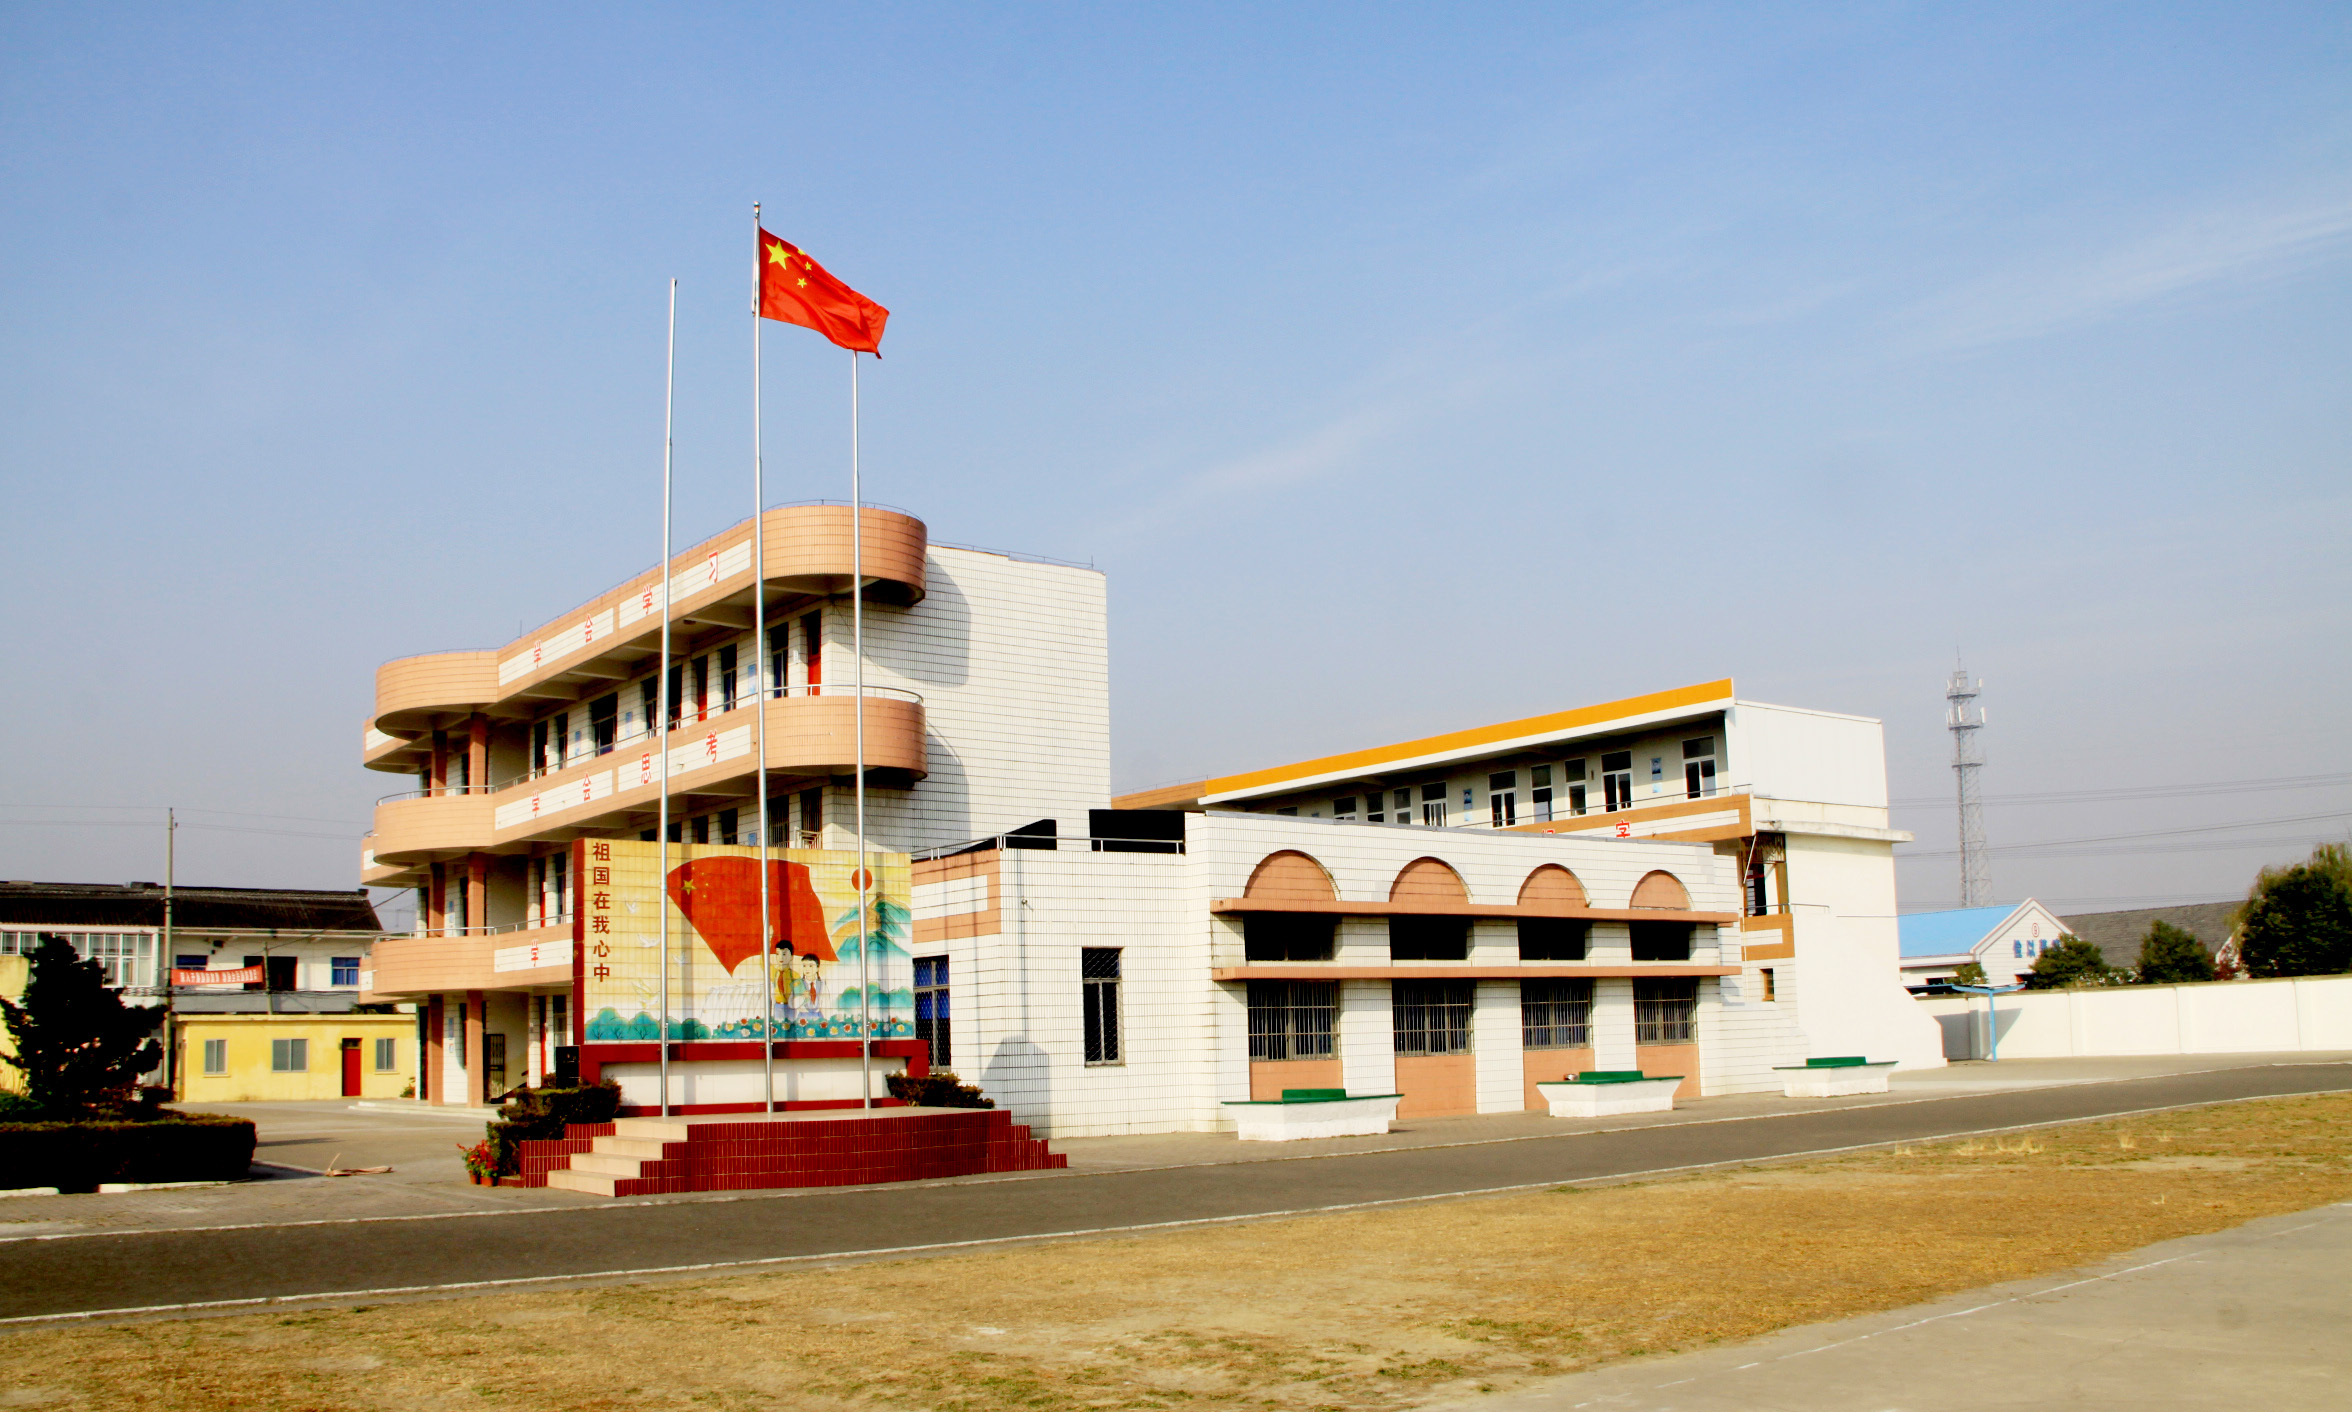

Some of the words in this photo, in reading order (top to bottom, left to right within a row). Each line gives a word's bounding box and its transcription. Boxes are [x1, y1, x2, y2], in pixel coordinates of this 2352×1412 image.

[533, 551, 719, 669] 学会学习
[531, 729, 718, 817] 学会思考
[531, 938, 539, 968] 学
[592, 842, 611, 982] 祖国在我心中
